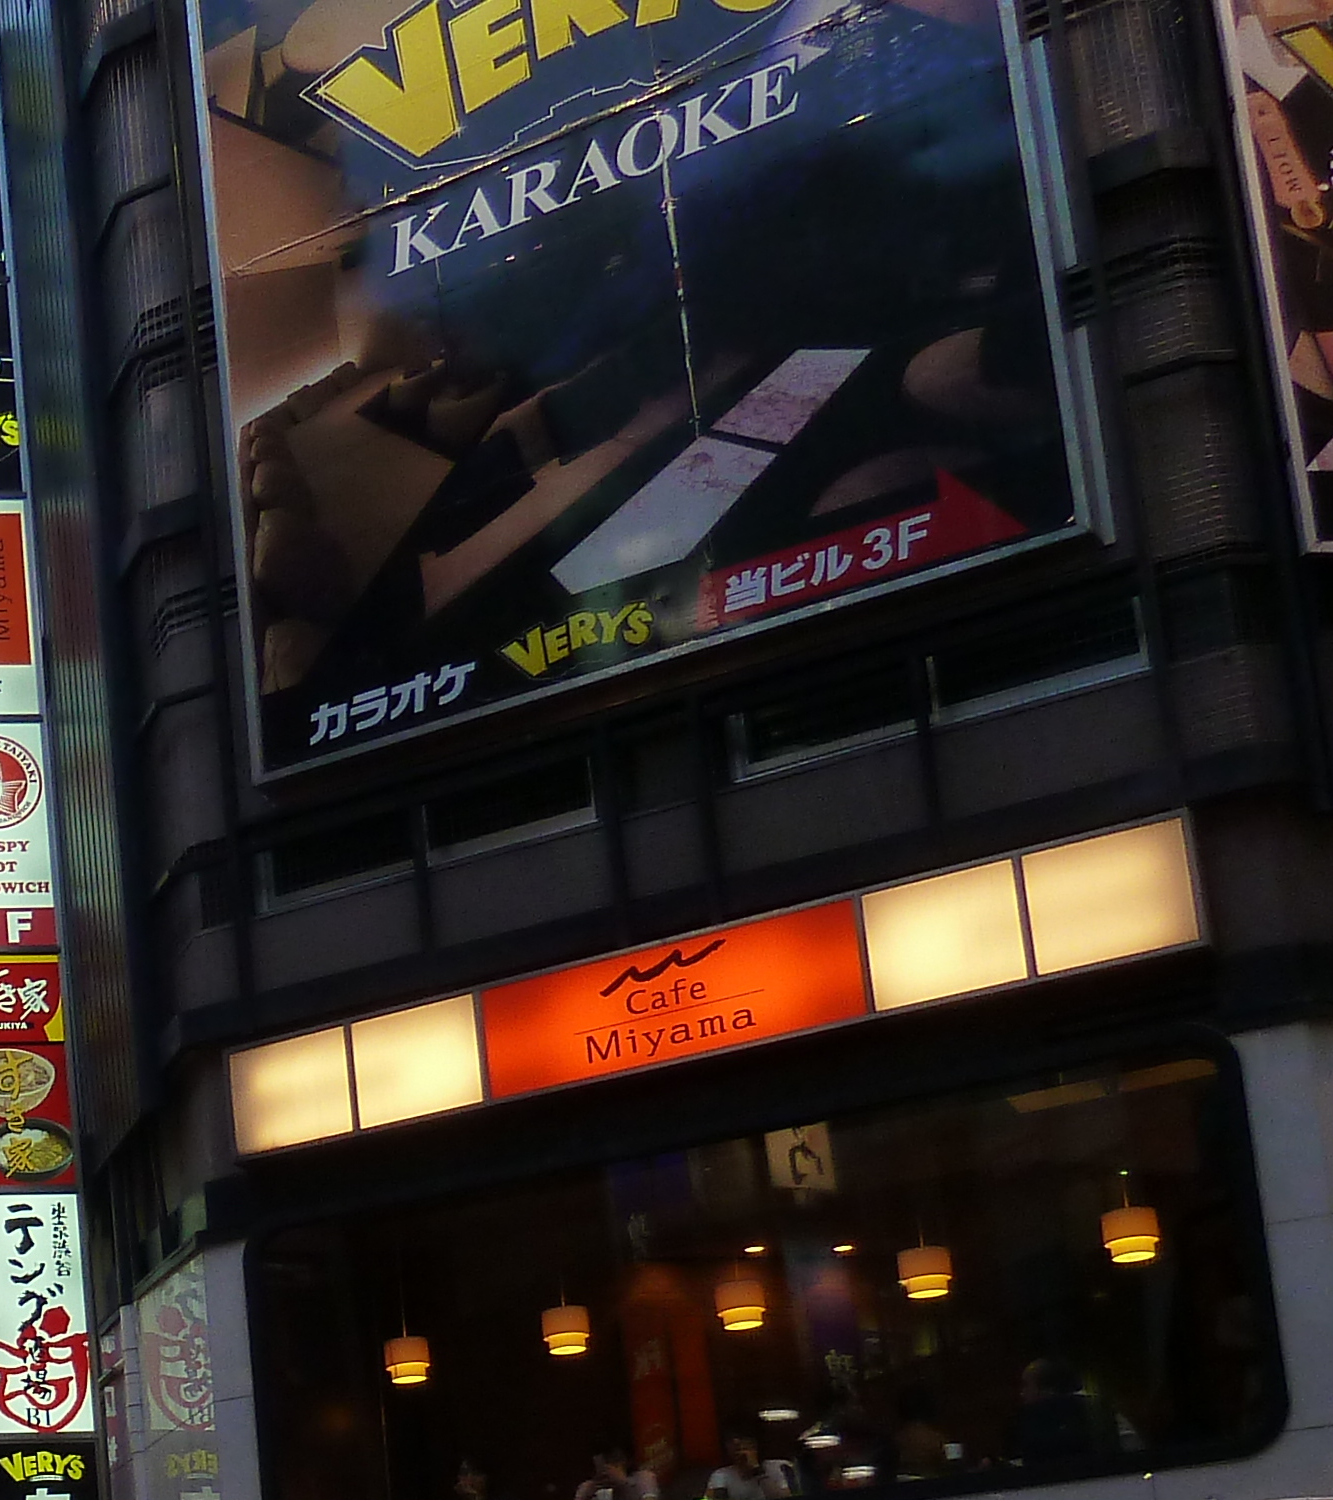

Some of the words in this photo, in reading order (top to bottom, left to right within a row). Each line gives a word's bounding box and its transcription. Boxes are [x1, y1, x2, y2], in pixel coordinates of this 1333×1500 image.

[387, 58, 801, 277] KARAOKE
[723, 551, 853, 613] 当ビル
[861, 512, 932, 571] 3F
[500, 600, 655, 677] VERY'S
[309, 660, 475, 746] カラオケ
[2, 741, 37, 785] TAIYAKI
[586, 1006, 757, 1064] Miyama
[625, 979, 707, 1015] Cafe
[51, 1202, 72, 1278] 東京渋谷
